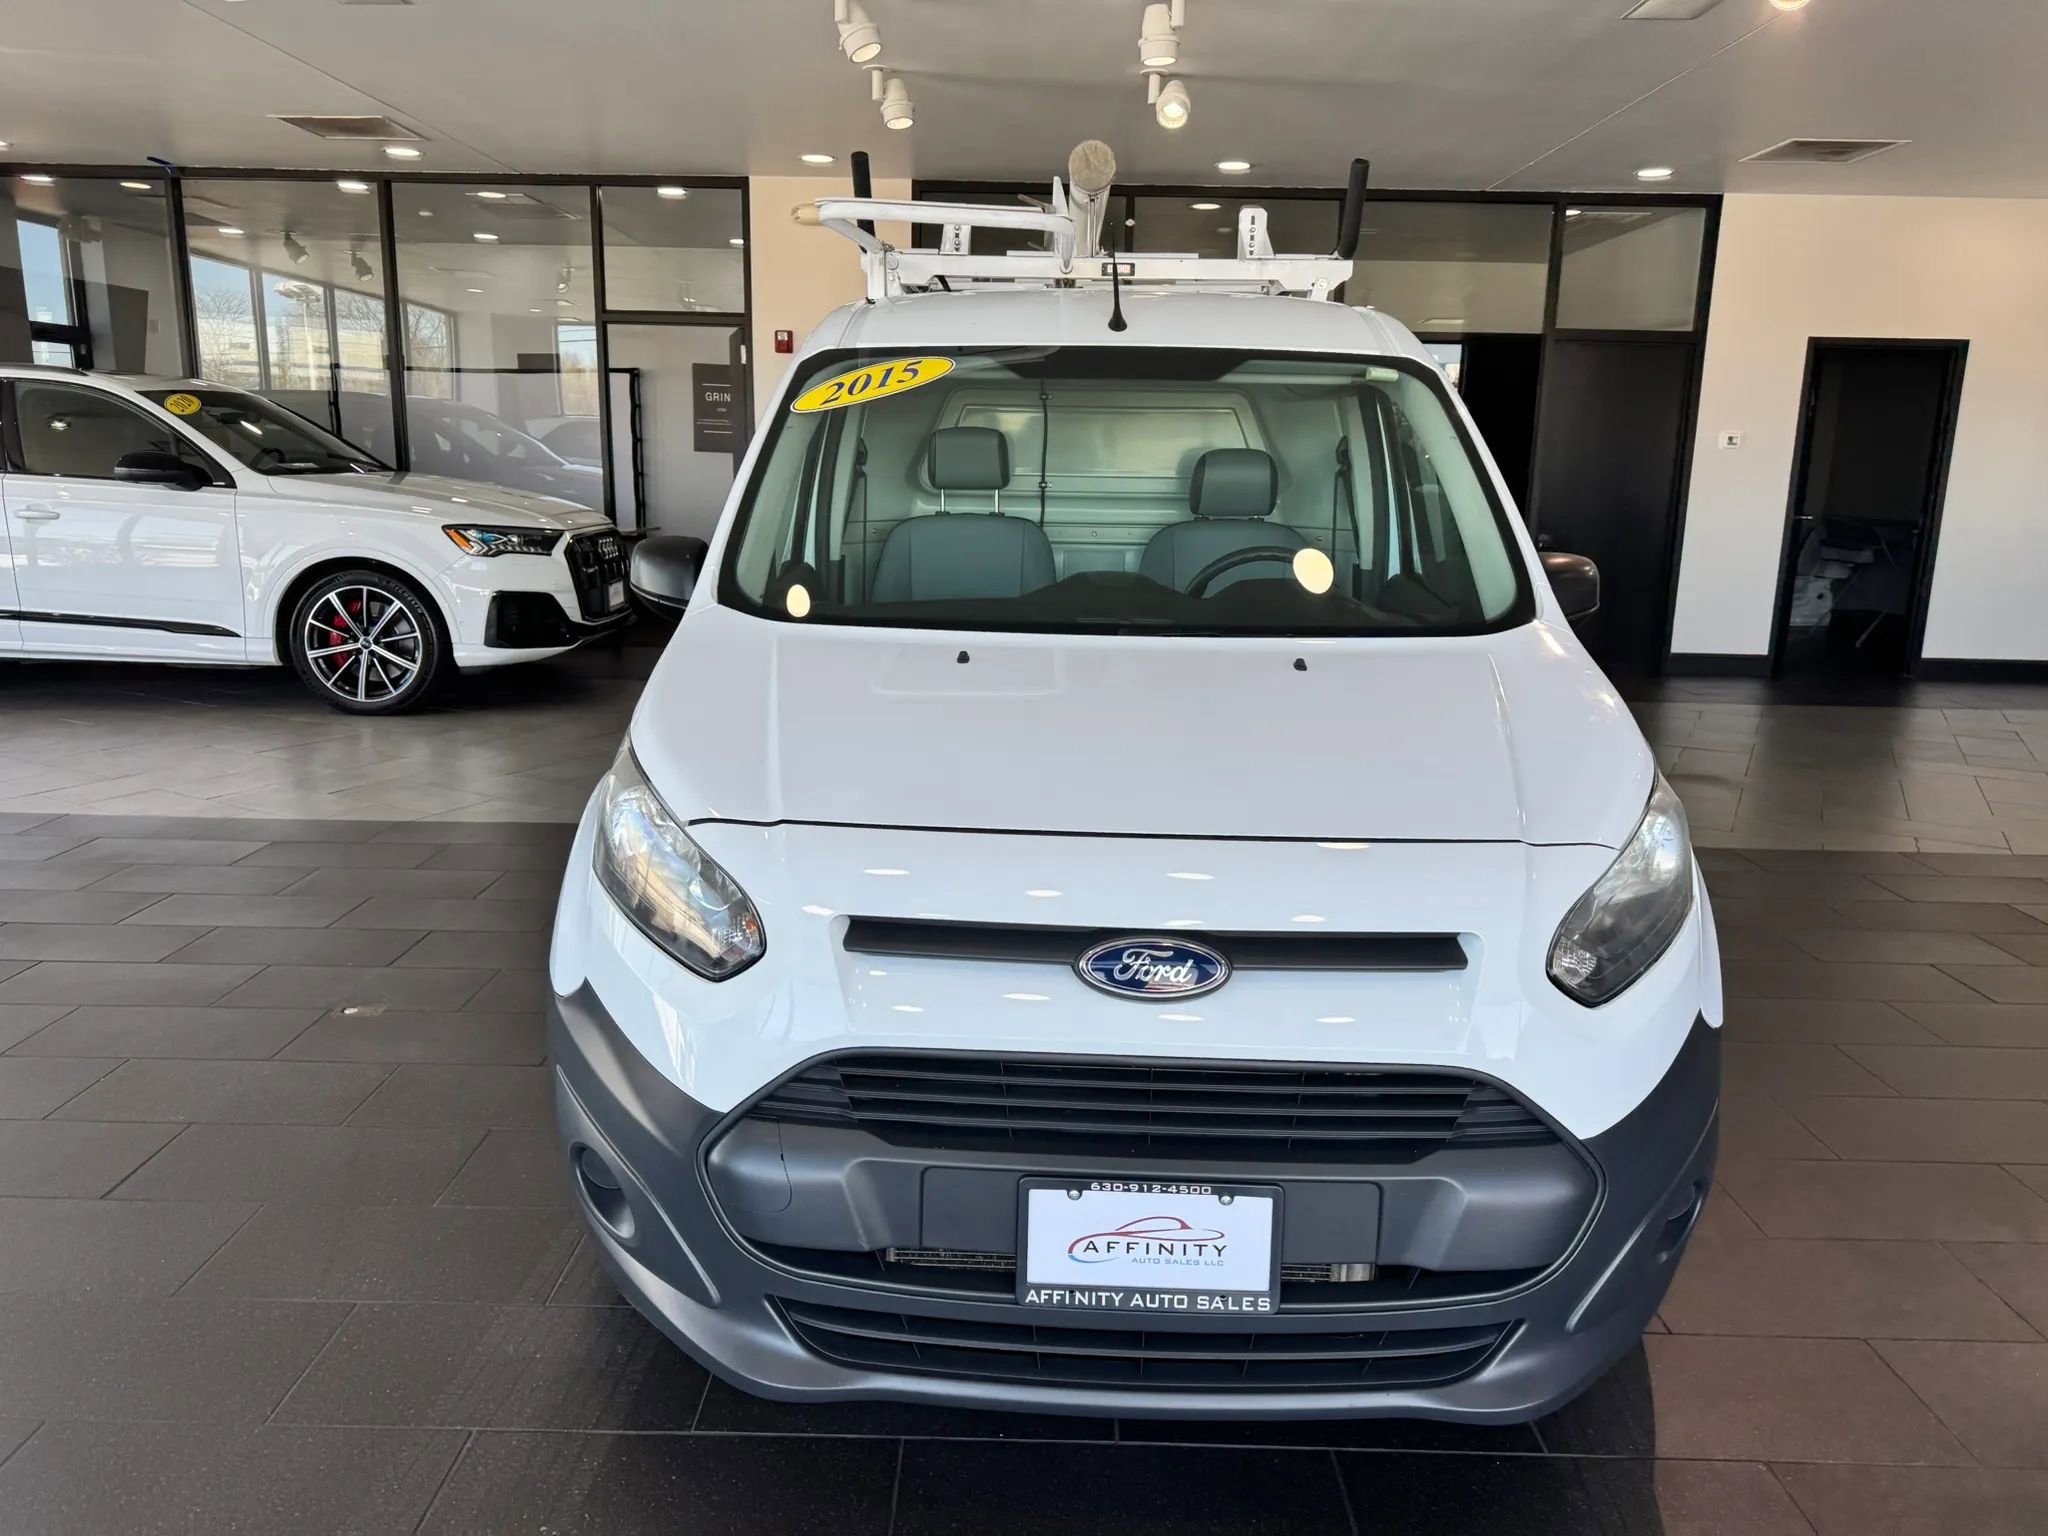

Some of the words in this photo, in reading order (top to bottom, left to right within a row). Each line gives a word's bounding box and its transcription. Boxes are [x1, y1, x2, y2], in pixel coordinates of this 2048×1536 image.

[819, 359, 923, 406] 2015
[705, 392, 731, 402] GRIN
[1113, 949, 1194, 983] Ford
[1090, 1182, 1212, 1195] 630-912-4500
[1083, 1240, 1227, 1257] AFFINITY
[1131, 1257, 1161, 1265] AUTO
[1165, 1258, 1200, 1266] SALES
[1204, 1259, 1224, 1267] LLC
[1025, 1289, 1124, 1307] AFFINITY
[1130, 1293, 1188, 1309] AUTO
[1196, 1296, 1271, 1311] SALES
